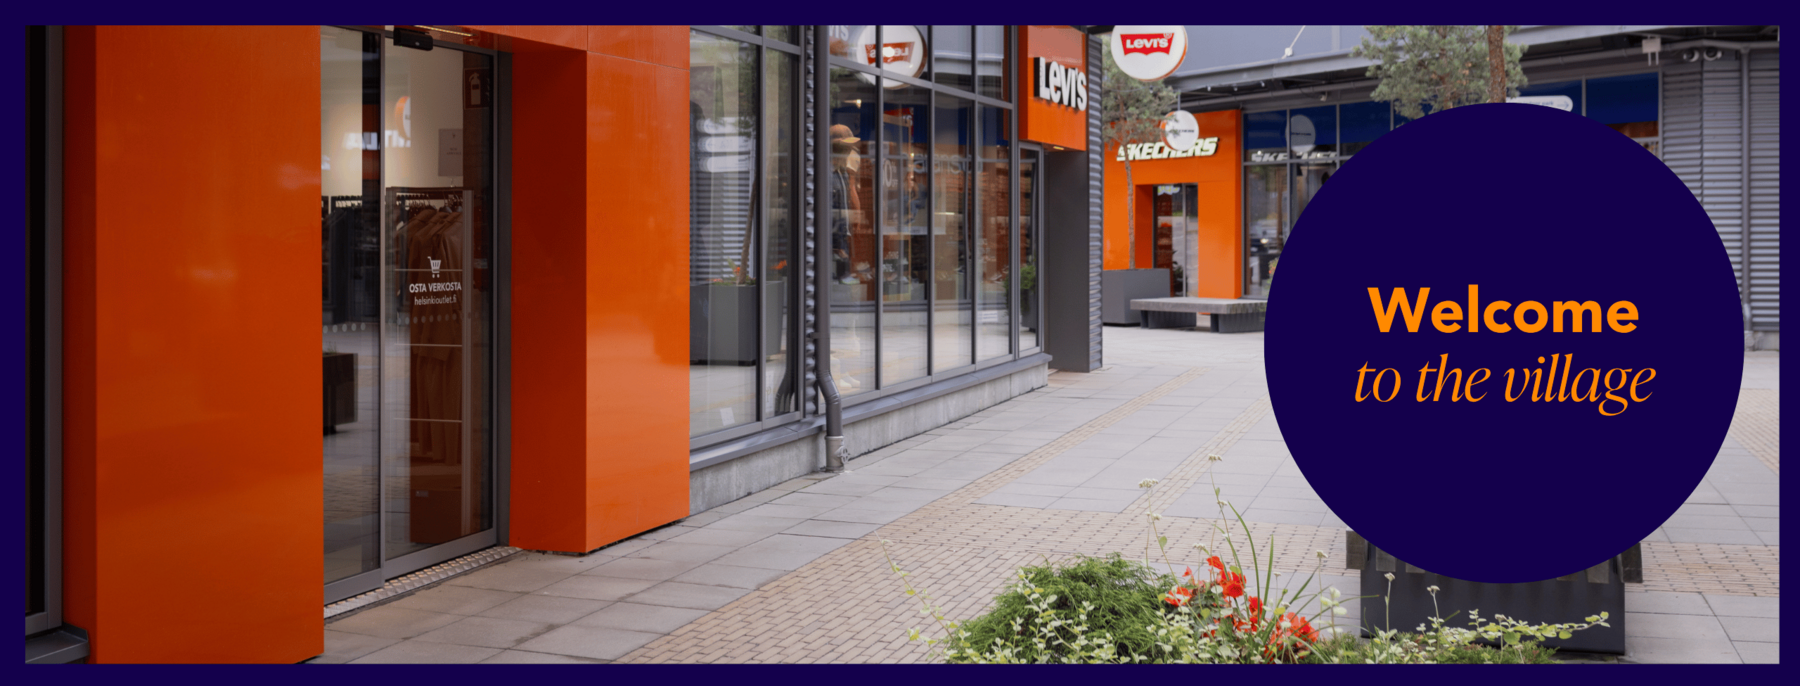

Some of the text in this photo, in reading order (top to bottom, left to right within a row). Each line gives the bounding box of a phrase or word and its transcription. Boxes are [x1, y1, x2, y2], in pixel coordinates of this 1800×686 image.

[409, 281, 462, 293] OSTA VERKOSTA
[414, 294, 457, 305] helsinkioutlet.fi
